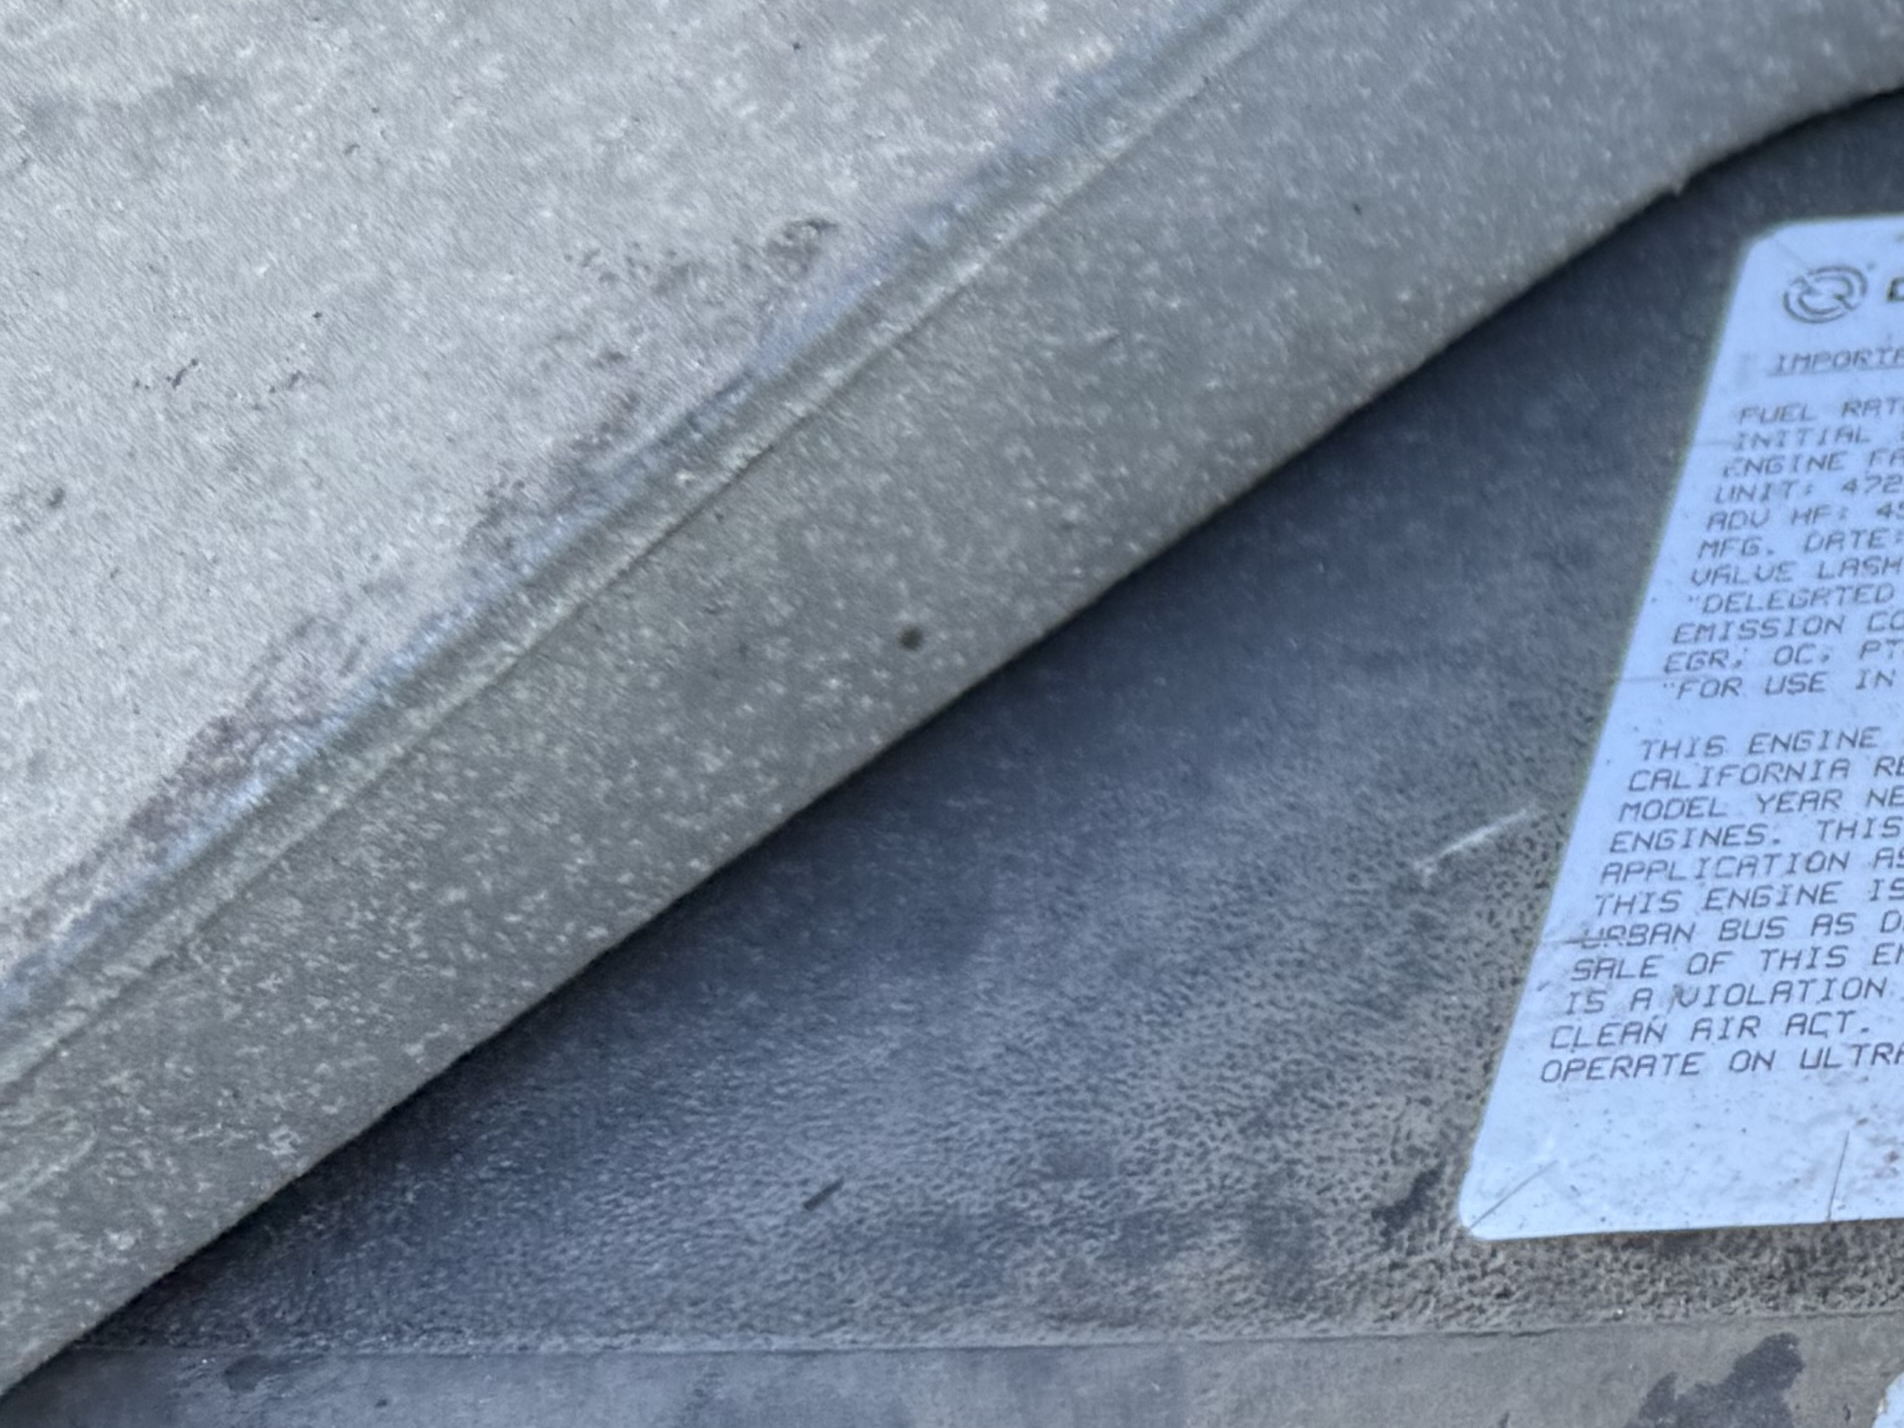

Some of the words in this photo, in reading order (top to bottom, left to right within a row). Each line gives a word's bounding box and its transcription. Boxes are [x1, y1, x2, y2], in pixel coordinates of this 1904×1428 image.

[1671, 614, 1845, 643] EMISSION
[1764, 671, 1830, 695] USE
[1851, 668, 1896, 690] IN
[1636, 734, 1726, 760] THIS
[1747, 726, 1881, 754] ENGINE
[1627, 758, 1851, 791] CALIFORNIA
[1618, 794, 1731, 821] MODEL
[1752, 789, 1843, 814] YEAR
[1608, 822, 1785, 852] ENGINES.
[1812, 816, 1903, 842] THIS
[1599, 849, 1850, 884] APPLICATION
[1589, 889, 1682, 916] THIS
[1703, 881, 1842, 910] ENGINE
[1717, 916, 1787, 941] BUS
[1809, 913, 1856, 937] AS
[1569, 954, 1663, 981] SALE
[1685, 951, 1732, 975] OF
[1754, 945, 1848, 972] THIS
[1559, 988, 1608, 1014] IS
[1629, 986, 1654, 1011] A
[1675, 975, 1887, 1009] VIOLATION
[1549, 1019, 1668, 1048] CLEAN
[1690, 1014, 1761, 1042] AIR
[1784, 1009, 1874, 1037] ACT.
[1537, 1051, 1704, 1082] OPERATE
[1727, 1048, 1775, 1073] ON
